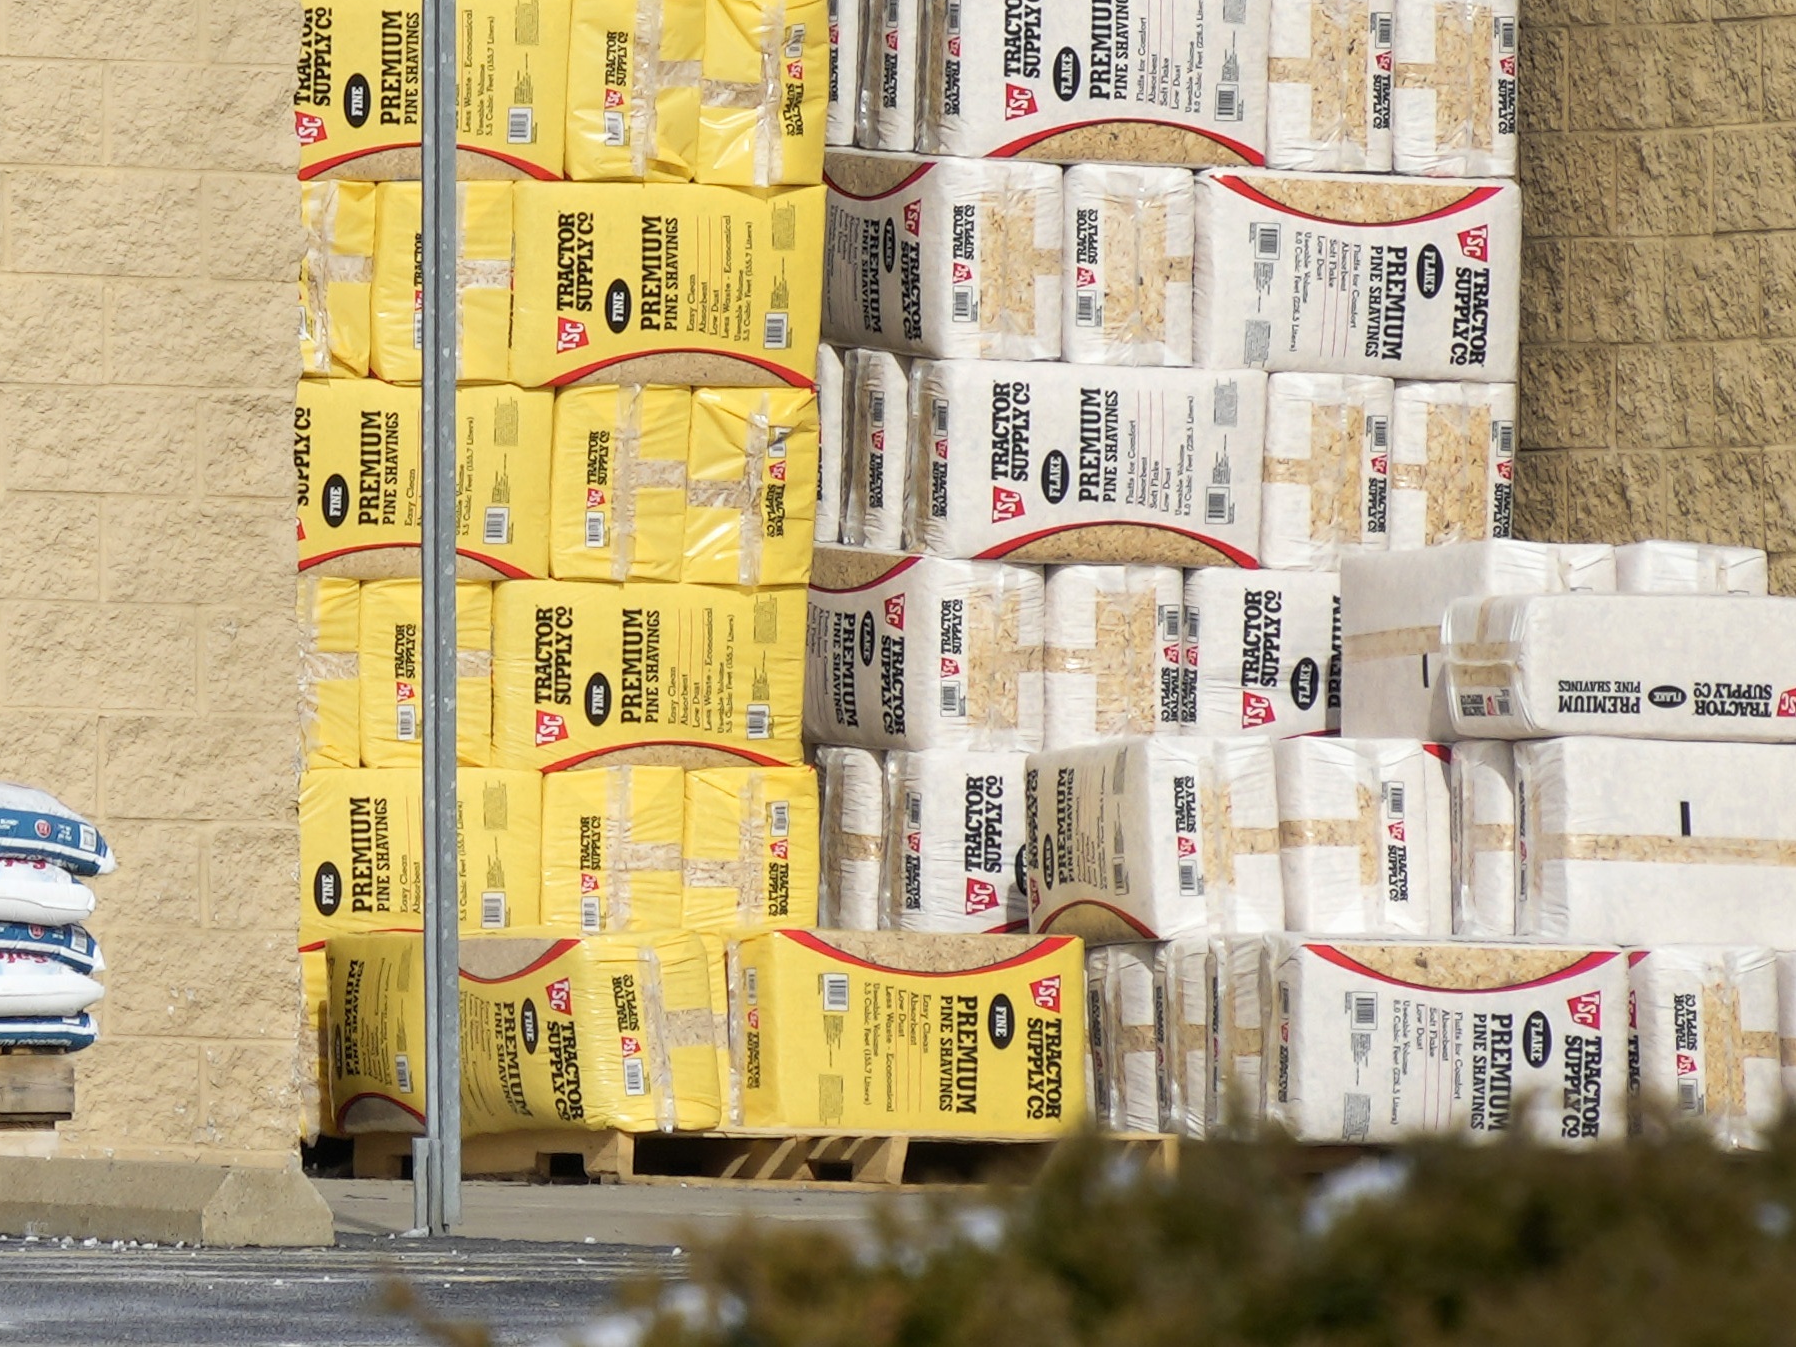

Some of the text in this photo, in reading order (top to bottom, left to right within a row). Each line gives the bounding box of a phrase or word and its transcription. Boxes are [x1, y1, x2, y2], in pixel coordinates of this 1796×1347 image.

[1023, 6, 1041, 78] SUPPLY
[1006, 89, 1031, 117] TSC
[1113, 66, 1127, 100] PINE
[557, 212, 575, 311] TRACTOR
[576, 237, 594, 311] SUPPLY
[640, 215, 662, 331] PREMIUM
[664, 217, 678, 331] PINE SHAVINGS
[1463, 227, 1486, 257] TSC
[557, 322, 584, 351] TSC
[1365, 246, 1383, 358] PINE SHAVINGS
[1381, 246, 1408, 361] PREMIUM
[1452, 266, 1472, 339] SUPPLY
[1468, 267, 1490, 366] TRACTOR
[535, 605, 553, 704] TRACTOR
[554, 630, 572, 705] SUPPLY
[620, 607, 643, 725] PREMIUM
[645, 609, 660, 725] PINE SHAVINGS
[1558, 680, 1641, 693] PINE SHAVINGS
[1713, 683, 1772, 700] SUPPLY
[536, 712, 564, 744] TSC
[1558, 695, 1641, 713] PREMIUM
[1694, 700, 1772, 718] TRACTOR
[1035, 977, 1059, 1007] TSC
[939, 995, 953, 1112] PINE SHAVINGS
[955, 994, 978, 1115] PREMIUM
[1027, 1018, 1044, 1093] SUPPLY
[1046, 1018, 1062, 1119] TRACTOR
